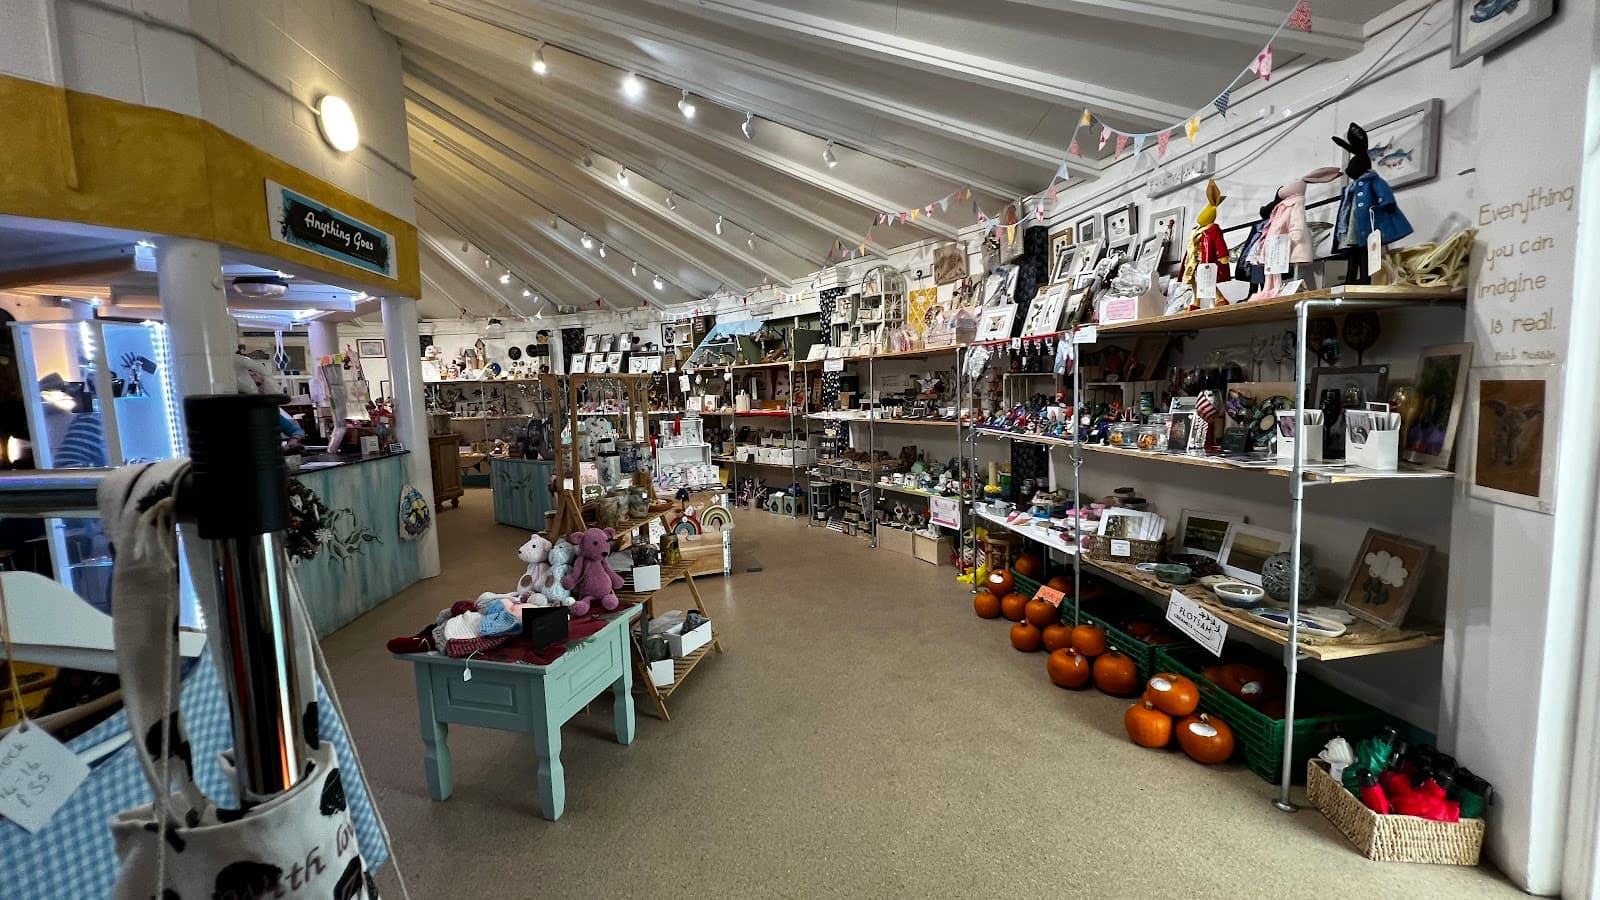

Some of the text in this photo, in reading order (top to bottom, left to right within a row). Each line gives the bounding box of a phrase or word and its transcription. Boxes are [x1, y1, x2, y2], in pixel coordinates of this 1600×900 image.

[1478, 184, 1575, 226] Everything
[304, 211, 374, 251] Anything Goes
[1486, 236, 1554, 271] you can
[1179, 606, 1212, 634] FLOTSAM
